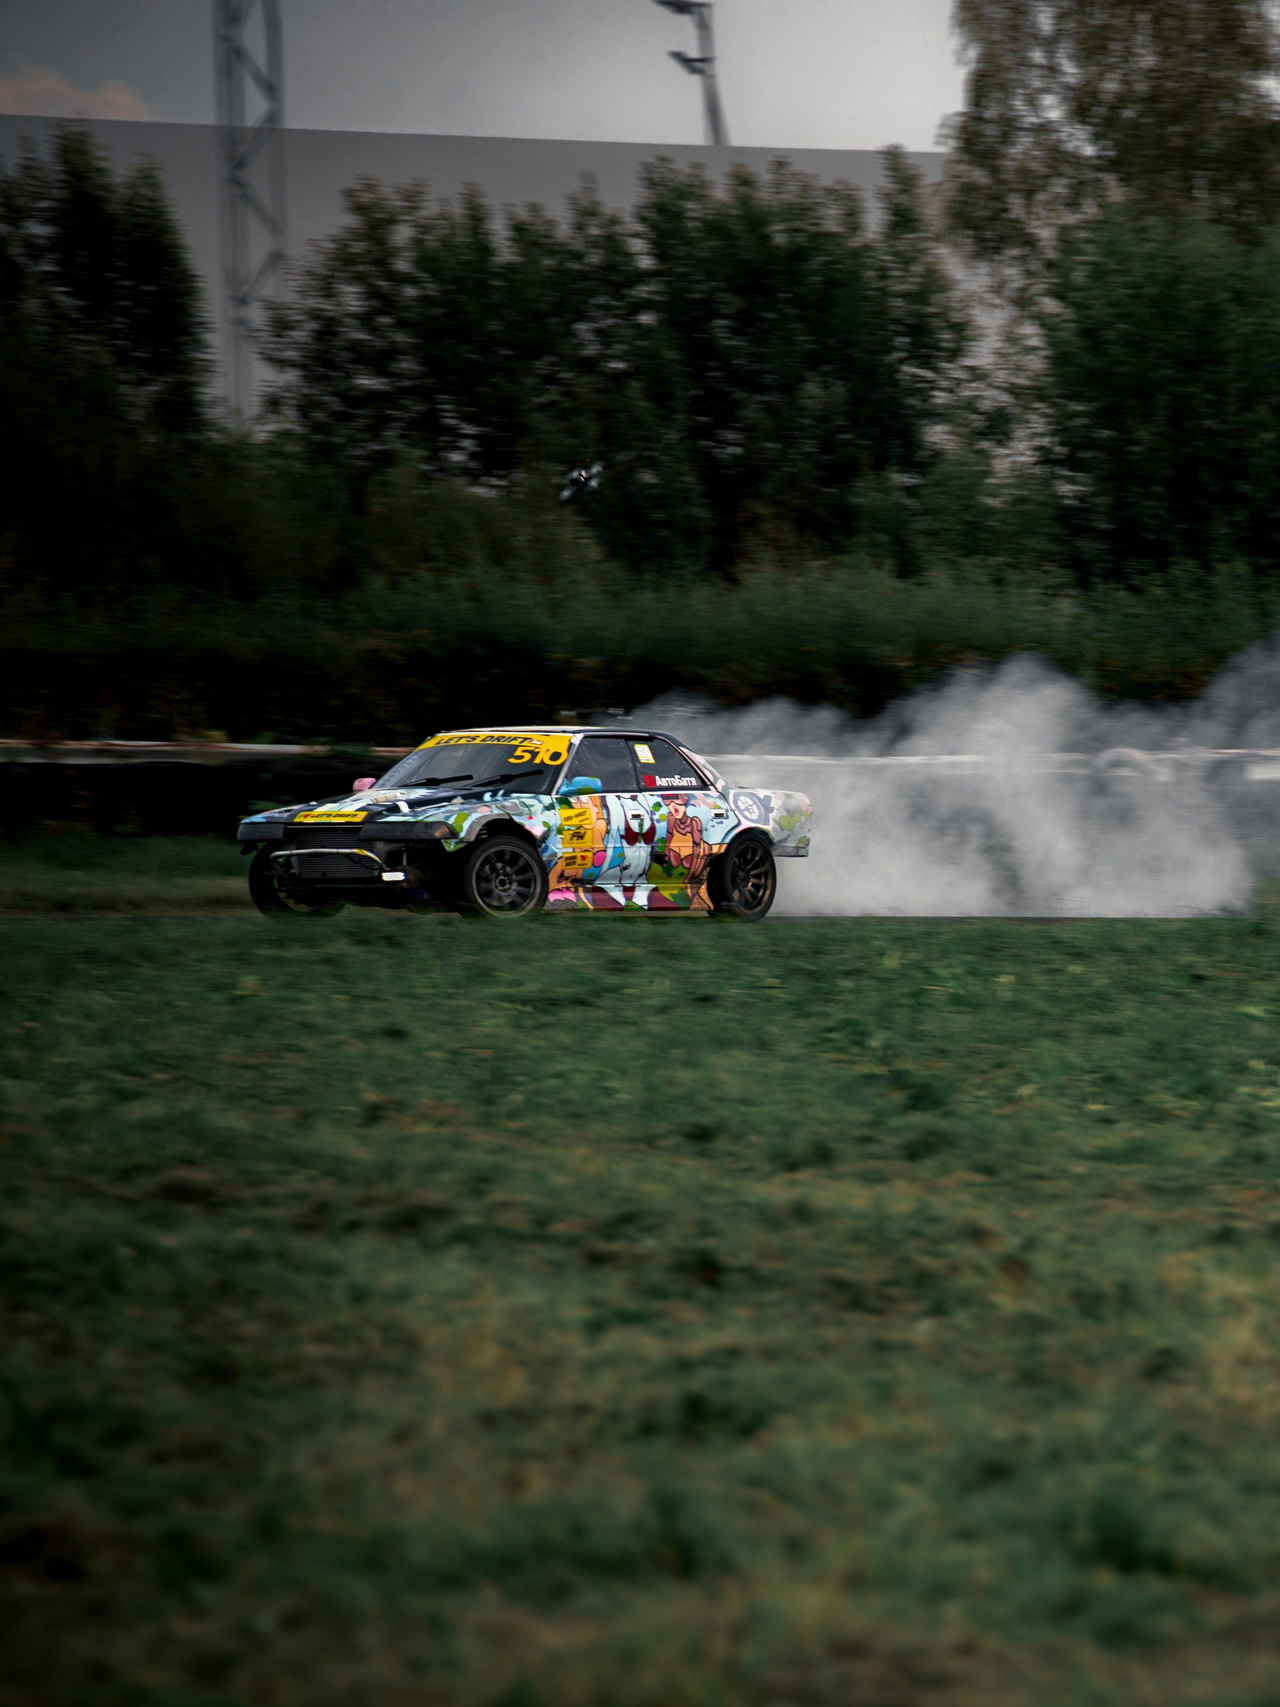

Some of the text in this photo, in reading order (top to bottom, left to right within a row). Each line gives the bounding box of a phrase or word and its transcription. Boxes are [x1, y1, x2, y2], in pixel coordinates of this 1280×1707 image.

[436, 736, 478, 745] LET'S
[482, 736, 531, 744] DRIFT
[508, 747, 569, 765] 510
[655, 775, 697, 787] АвтоБатя
